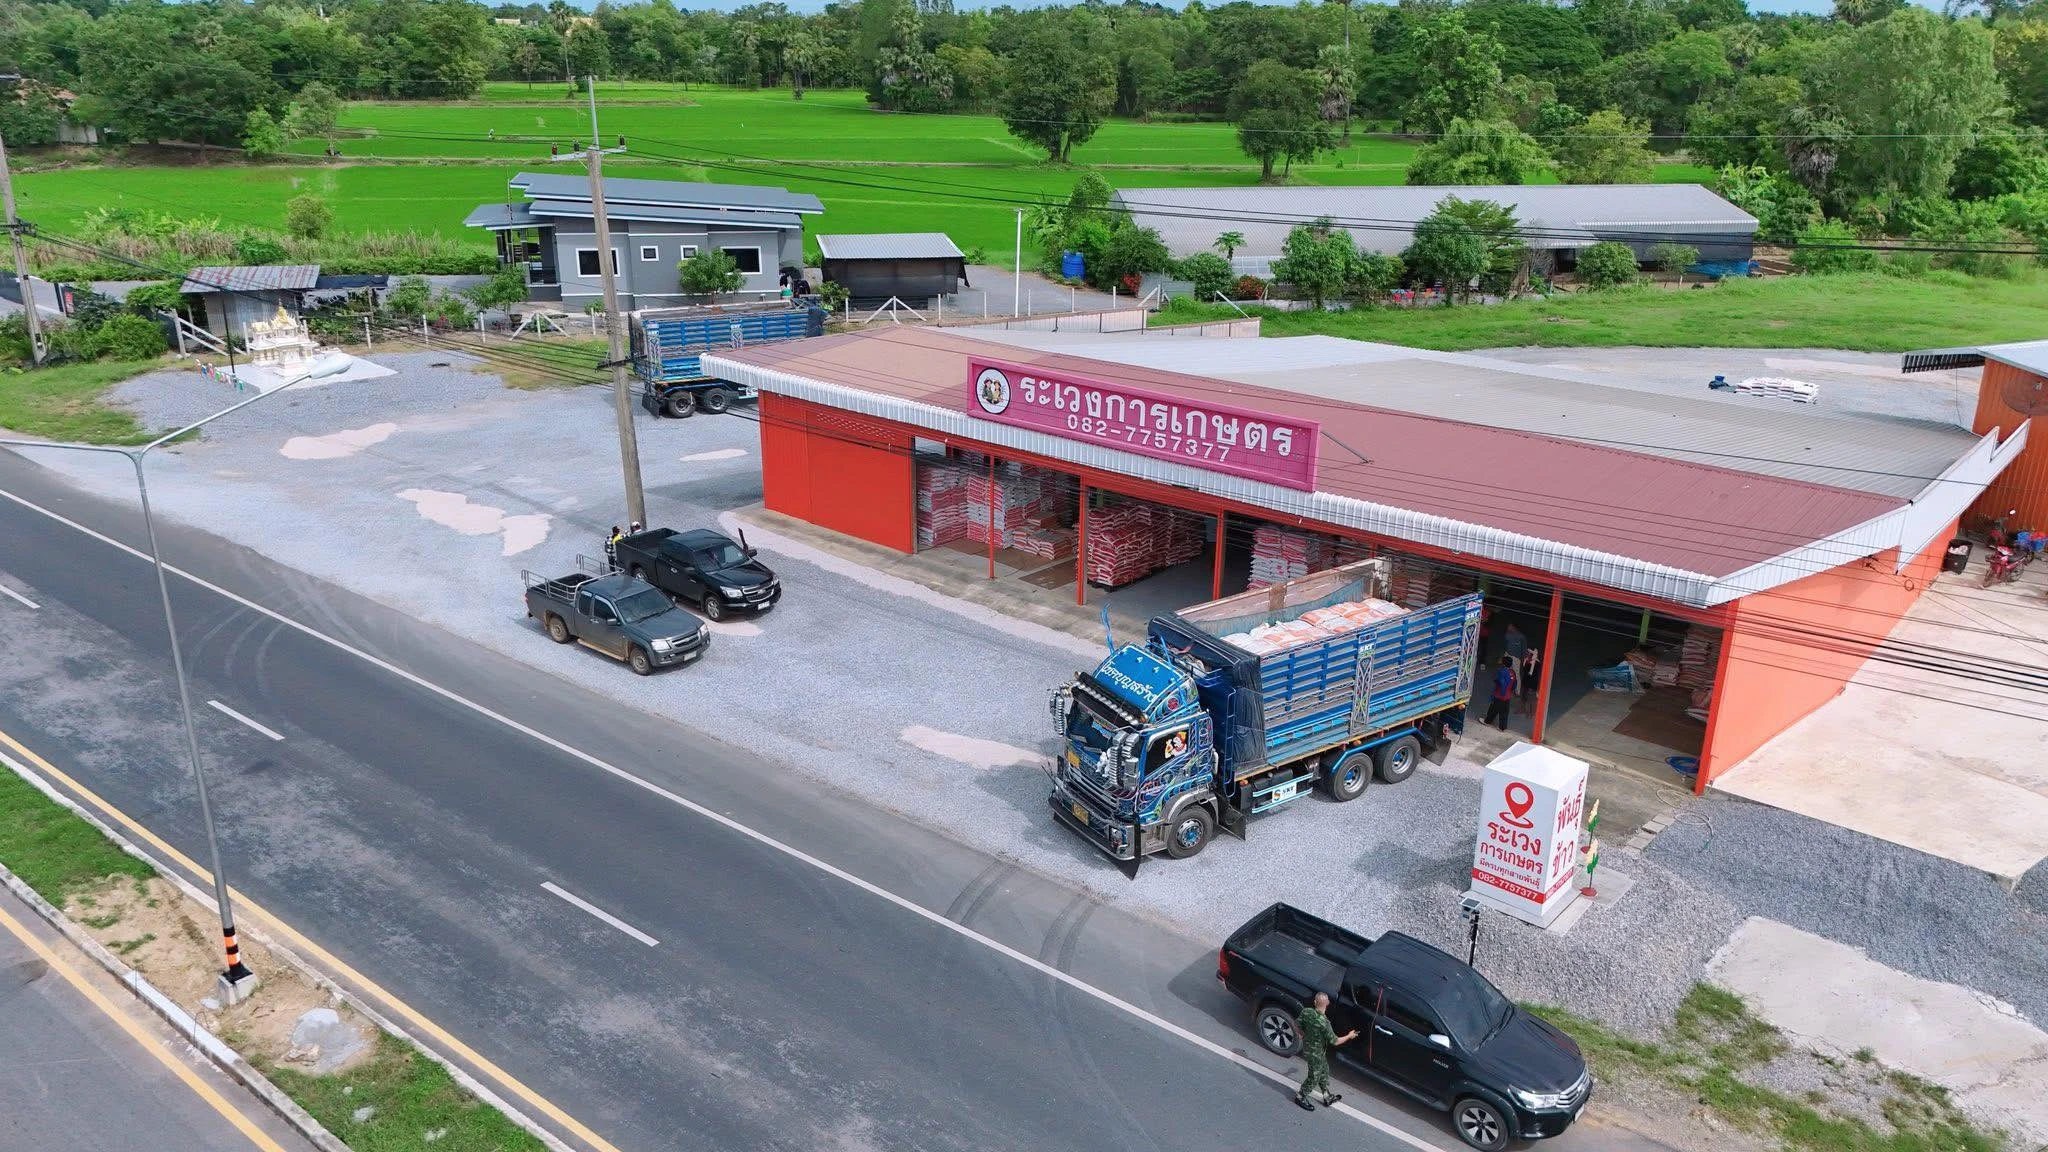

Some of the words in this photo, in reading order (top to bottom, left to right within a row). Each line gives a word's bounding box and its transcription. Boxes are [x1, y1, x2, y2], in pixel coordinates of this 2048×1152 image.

[1020, 376, 1293, 457] ระเวงการเกษตร
[1067, 414, 1230, 462] 082-7757377
[1488, 821, 1542, 856] ระเวง
[1480, 842, 1544, 875] การเกษตร
[1552, 840, 1575, 878] ข้าว
[1478, 872, 1539, 900] 082-7757377
